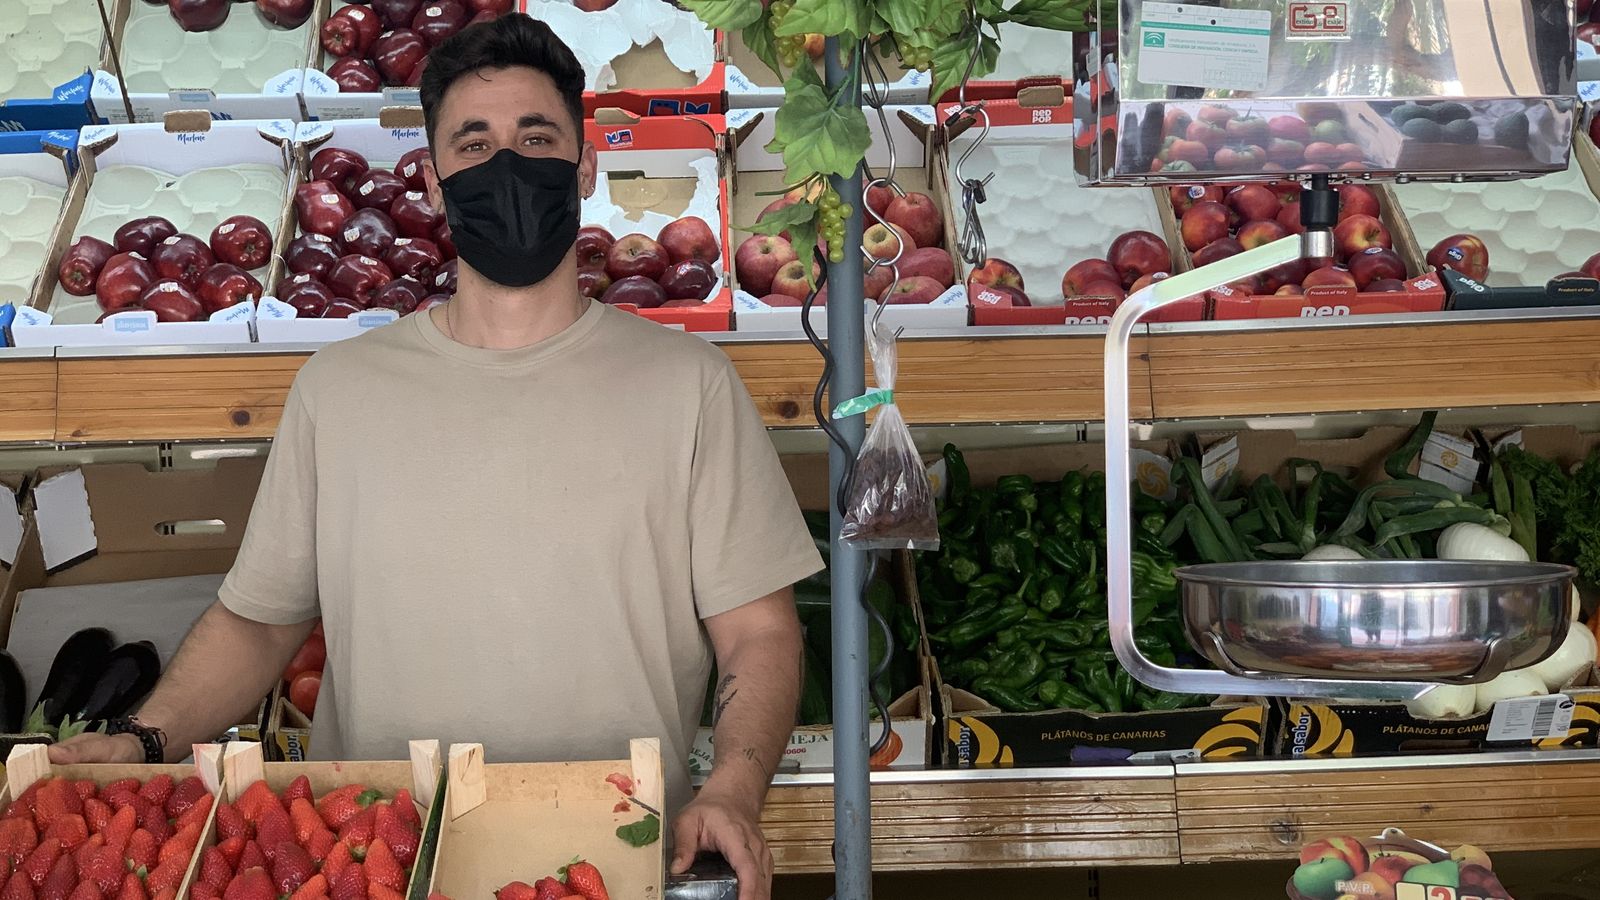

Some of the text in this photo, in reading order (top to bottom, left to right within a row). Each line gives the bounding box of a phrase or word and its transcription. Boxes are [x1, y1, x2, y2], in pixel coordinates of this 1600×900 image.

[1459, 277, 1485, 292] Giga
[1292, 712, 1311, 744] sabor
[1382, 723, 1438, 735] PLÁTANOS
[1440, 727, 1454, 735] DE
[1041, 729, 1166, 742] PLÁTANOS DE CANARIAS
